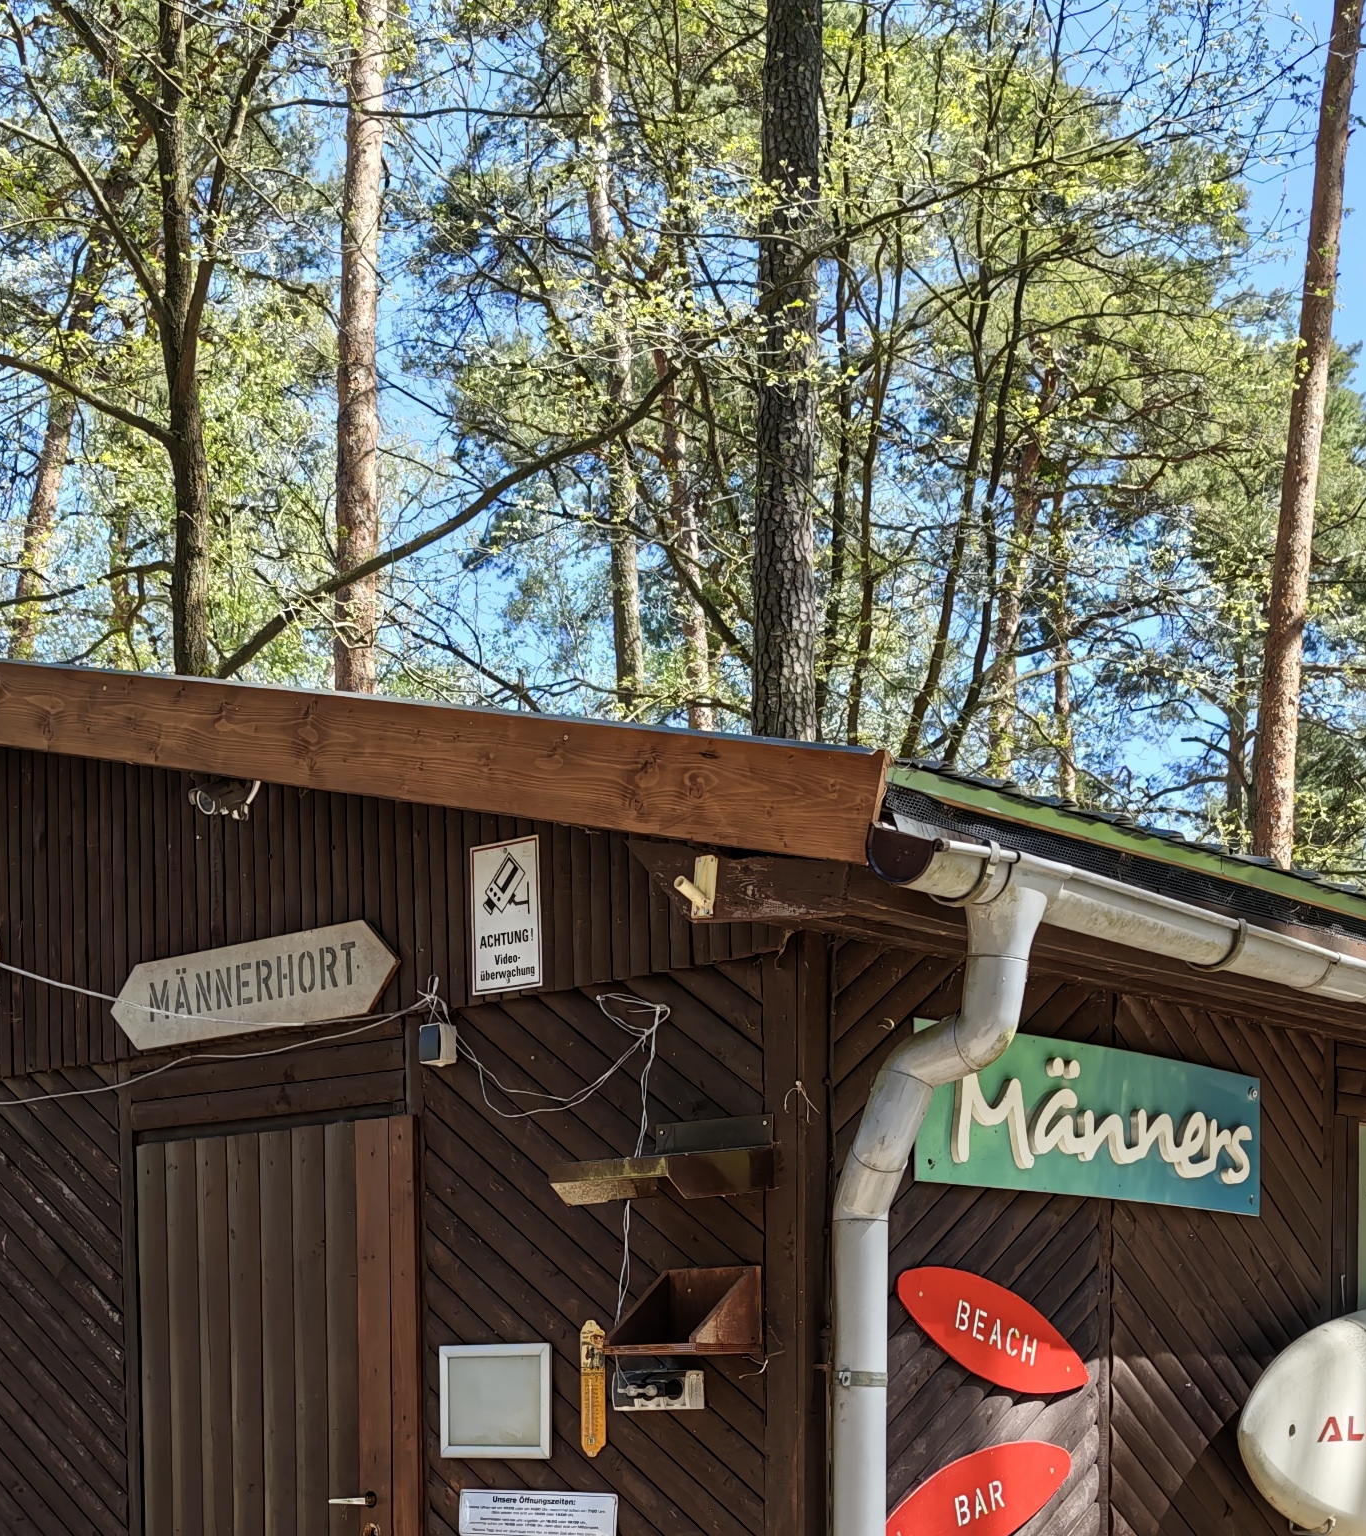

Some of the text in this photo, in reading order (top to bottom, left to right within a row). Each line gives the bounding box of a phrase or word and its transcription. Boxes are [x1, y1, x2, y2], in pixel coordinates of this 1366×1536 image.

[479, 927, 534, 949] ACHTUNG!
[480, 965, 536, 982] überwachung
[494, 953, 521, 966] Video-
[148, 940, 357, 1023] MÄNNERHORT
[951, 1056, 1253, 1185] Männers
[954, 1299, 1038, 1367] BEACH
[492, 1495, 577, 1506] Unsere Öffnungszeiten:
[954, 1480, 1006, 1527] BAR
